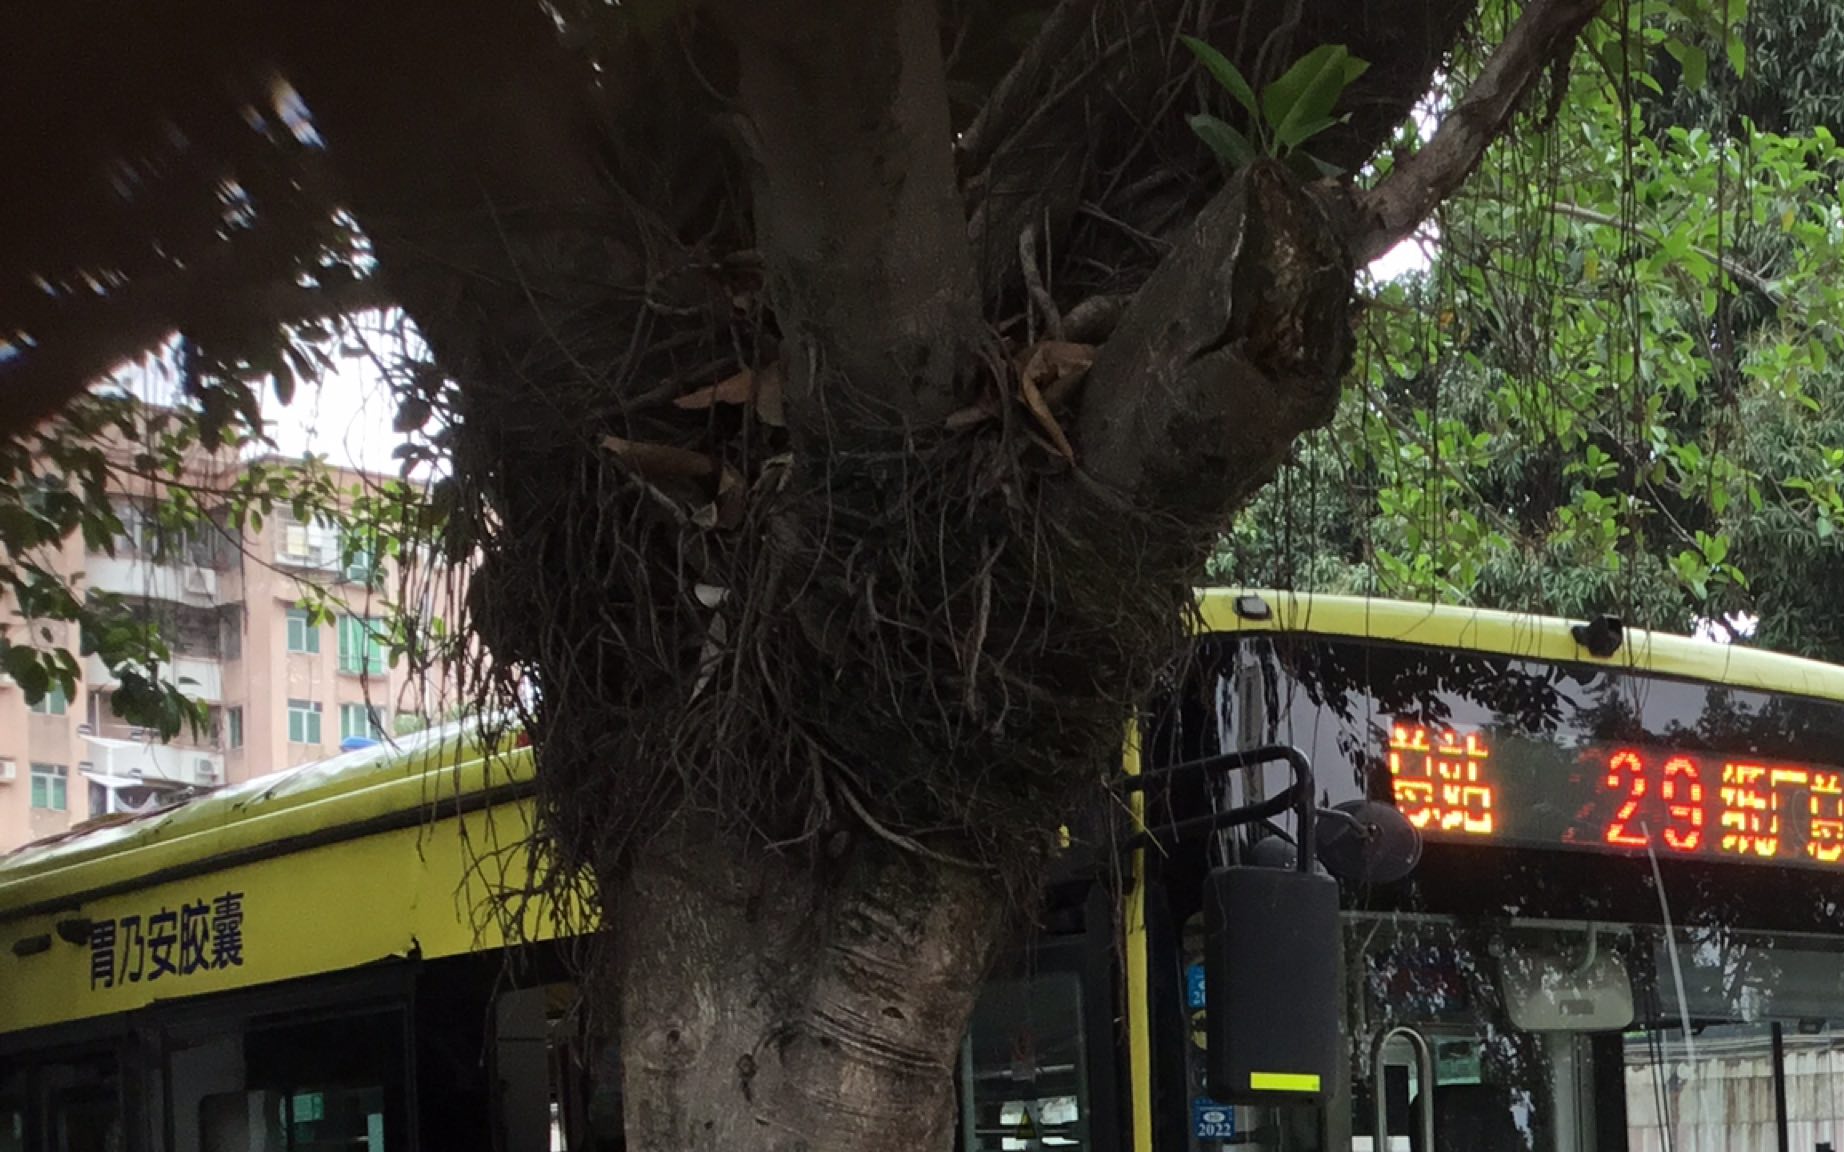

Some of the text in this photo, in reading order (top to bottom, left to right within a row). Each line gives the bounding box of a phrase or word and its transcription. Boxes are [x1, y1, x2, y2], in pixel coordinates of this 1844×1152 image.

[1606, 751, 1703, 849] 29
[90, 890, 244, 992] 胃乃安胶囊
[1198, 1122, 1231, 1137] 2022
